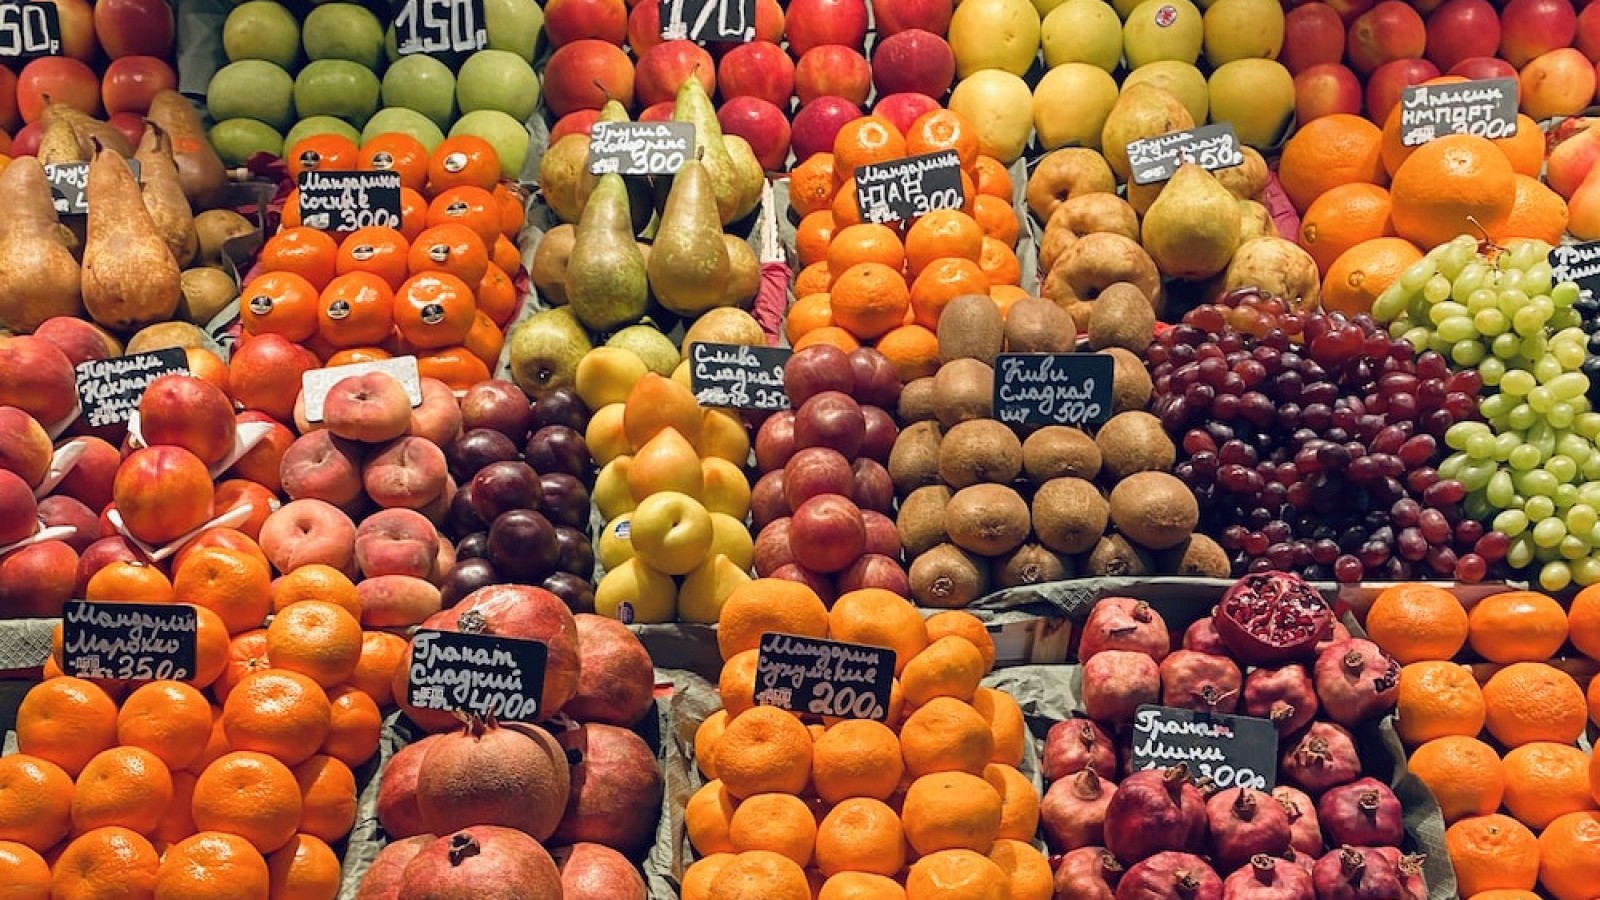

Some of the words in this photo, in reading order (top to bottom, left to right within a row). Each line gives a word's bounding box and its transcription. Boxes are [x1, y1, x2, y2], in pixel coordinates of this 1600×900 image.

[591, 121, 672, 144] Груша
[913, 188, 963, 216] 300р
[336, 208, 399, 232] 300р
[695, 344, 760, 367] Слива
[1002, 355, 1068, 383] Киви
[1000, 378, 1095, 415] Сладкая
[1053, 401, 1101, 423] 50р
[413, 632, 518, 669] Гранат
[118, 655, 187, 681] 350р
[410, 662, 522, 703] Сладкий
[469, 689, 536, 718] 400р
[808, 681, 884, 719] 200р
[1134, 710, 1234, 740] Гранат
[1134, 739, 1226, 761] Мини
